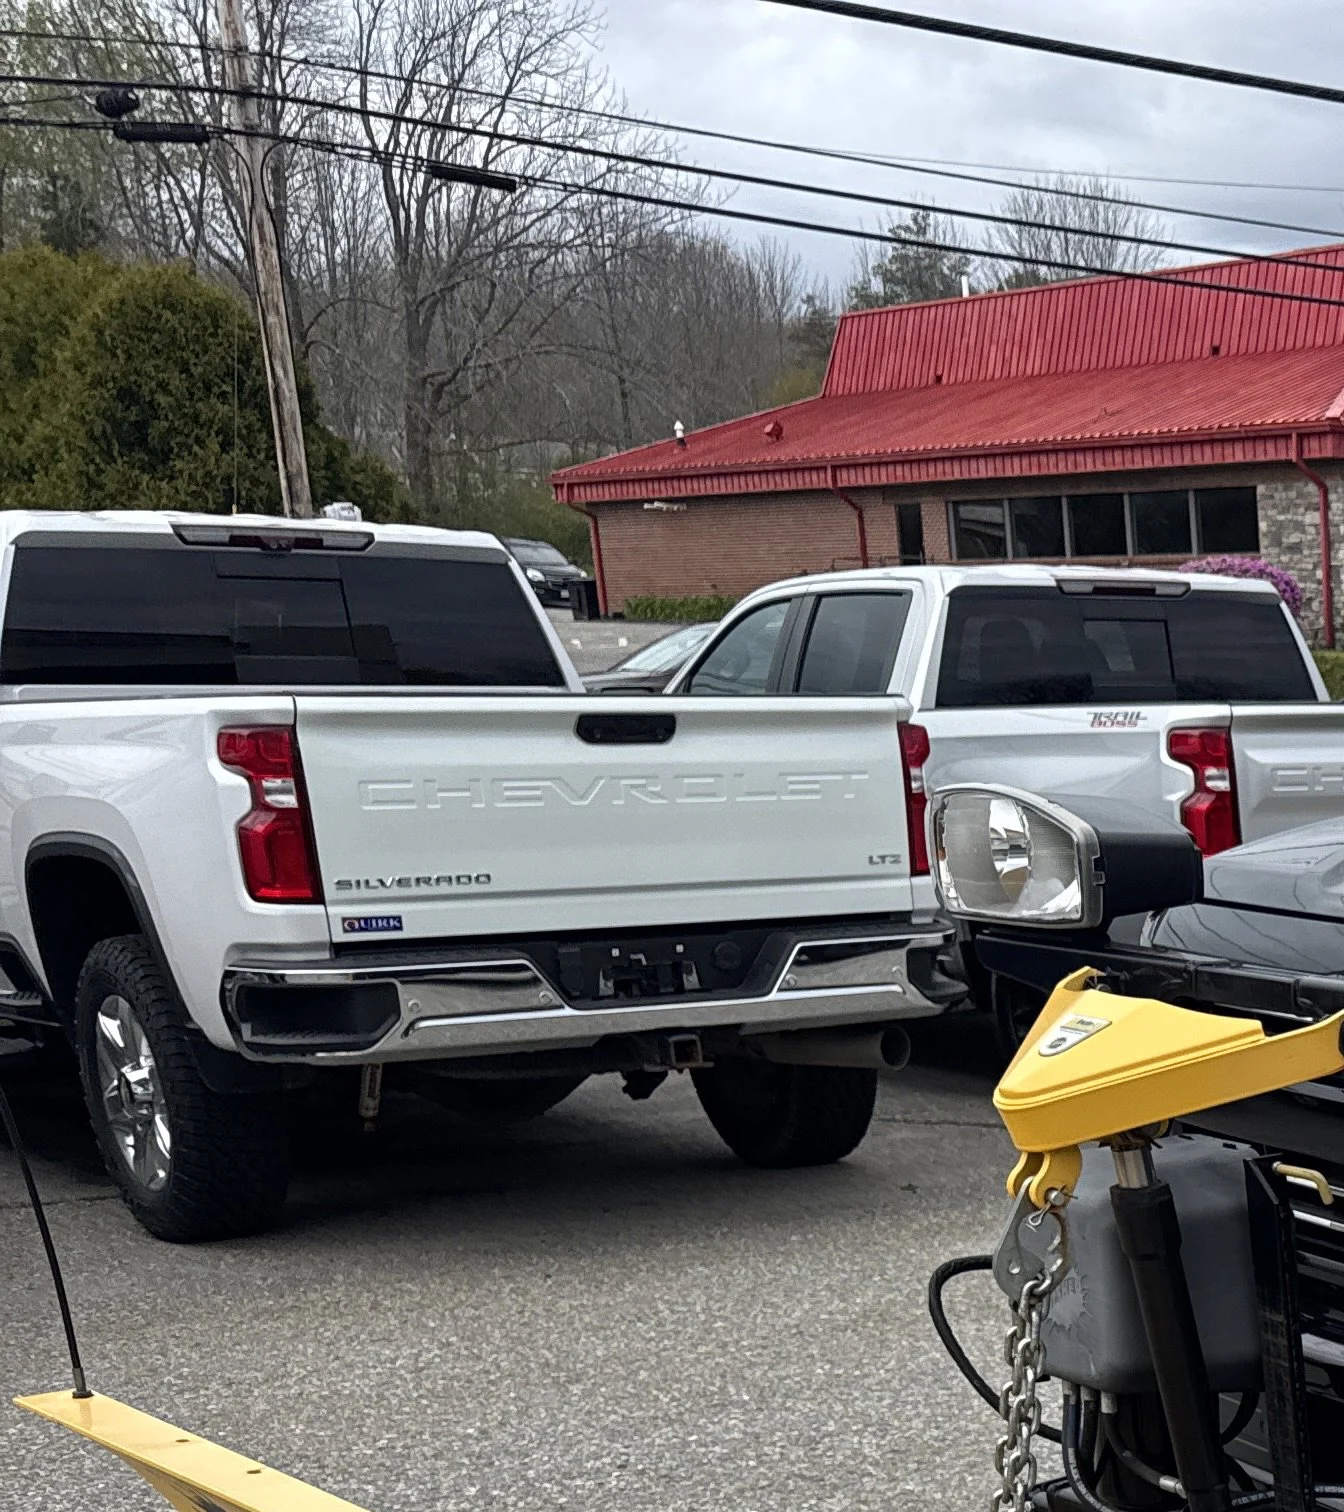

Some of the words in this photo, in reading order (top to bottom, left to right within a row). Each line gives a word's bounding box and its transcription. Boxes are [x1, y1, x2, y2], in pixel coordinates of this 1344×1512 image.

[357, 768, 869, 811] CHEVROLET
[868, 853, 902, 866] LTZ
[334, 872, 492, 891] SILVERADO
[342, 915, 401, 933] QUIRK
